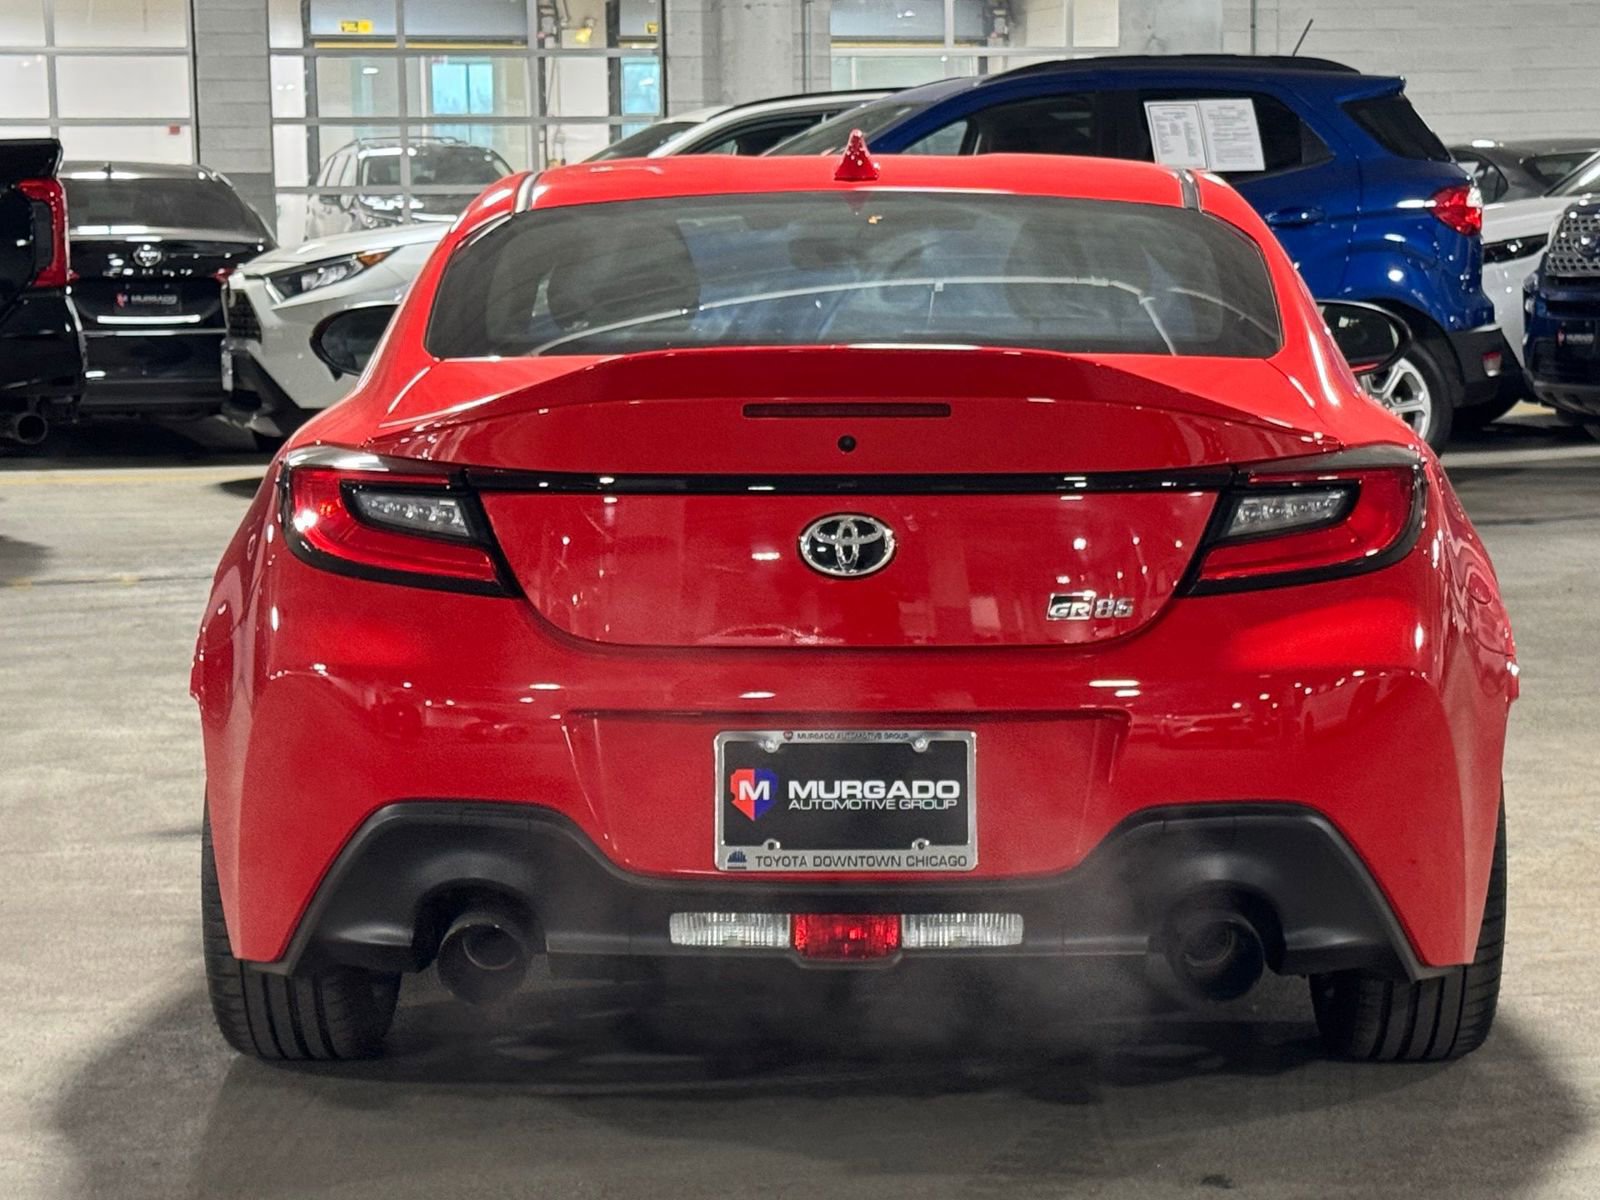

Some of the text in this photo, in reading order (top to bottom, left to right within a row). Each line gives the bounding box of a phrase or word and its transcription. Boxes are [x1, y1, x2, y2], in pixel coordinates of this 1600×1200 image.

[797, 732, 836, 740] MURGADO
[884, 732, 909, 740] GROUP
[738, 780, 770, 801] M
[788, 780, 961, 800] MURGADO
[788, 799, 958, 811] AUTOMOTIVE GROUP
[755, 855, 968, 868] TOYOTA DOWNTOWN CHICAGO
